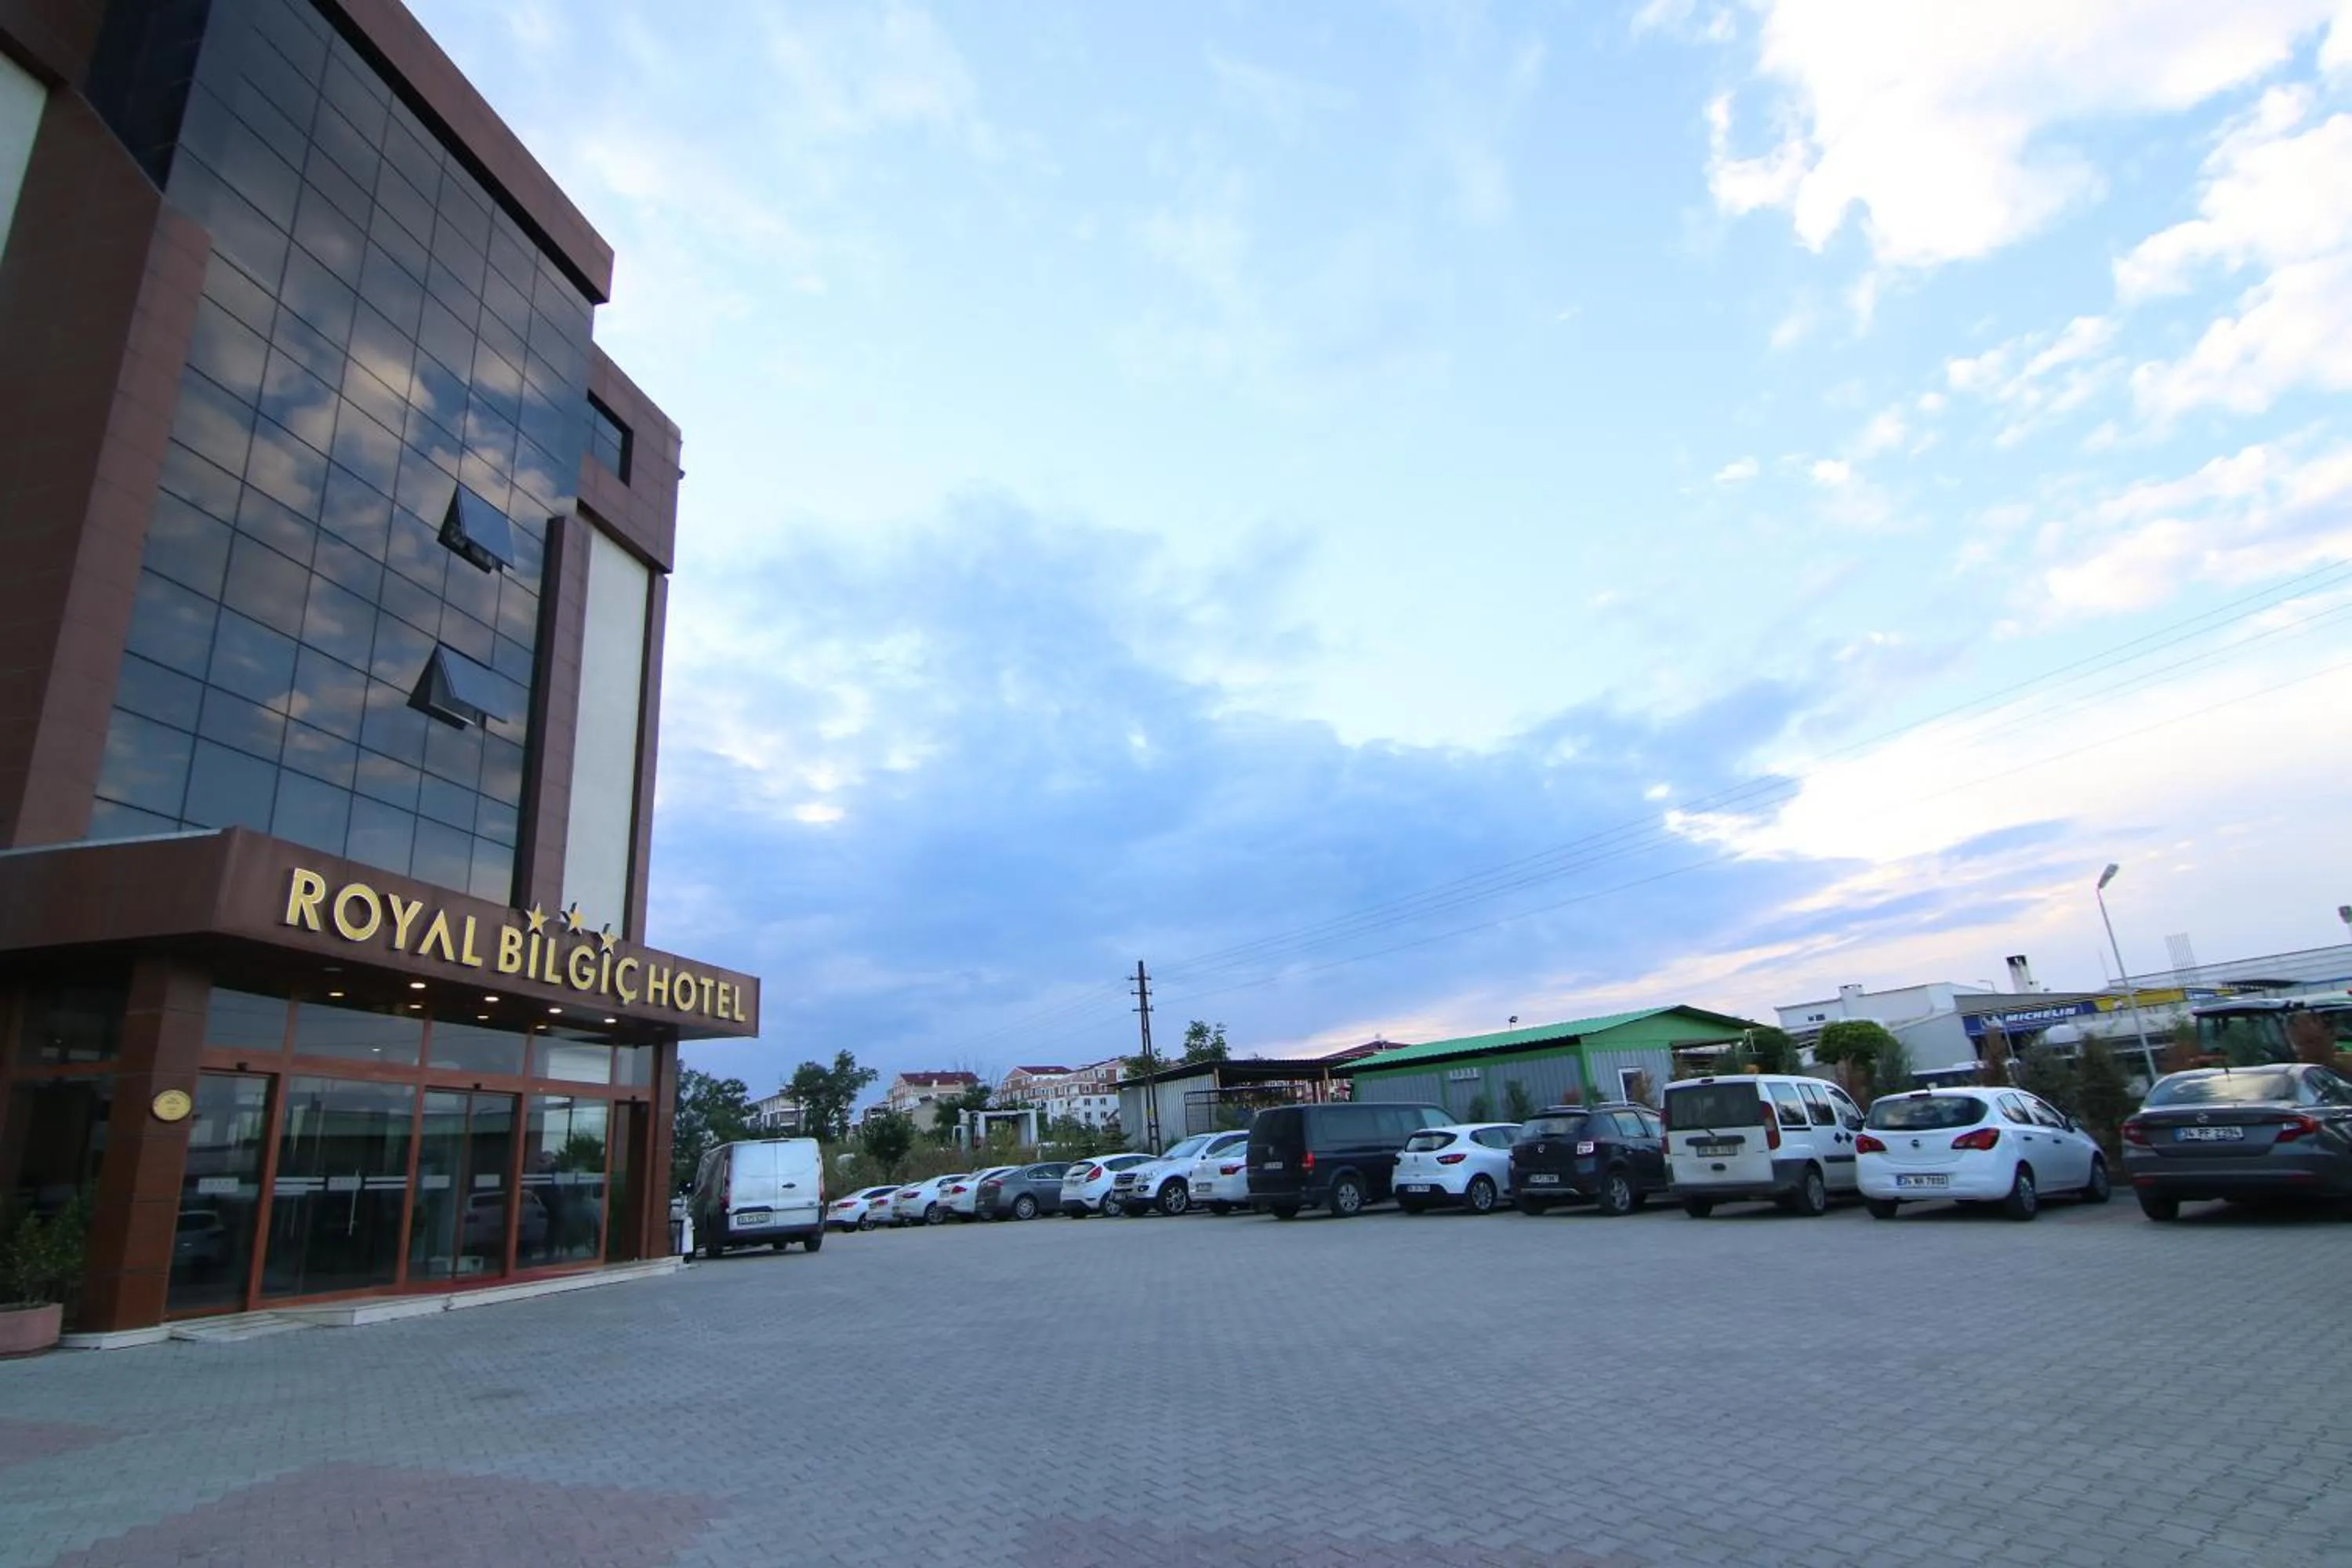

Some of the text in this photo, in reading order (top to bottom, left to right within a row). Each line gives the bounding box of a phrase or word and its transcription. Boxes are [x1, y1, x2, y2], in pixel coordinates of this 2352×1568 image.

[285, 866, 484, 967] ROYAL
[646, 962, 746, 1022] HOTEL
[2005, 1006, 2078, 1022] MICHELIN
